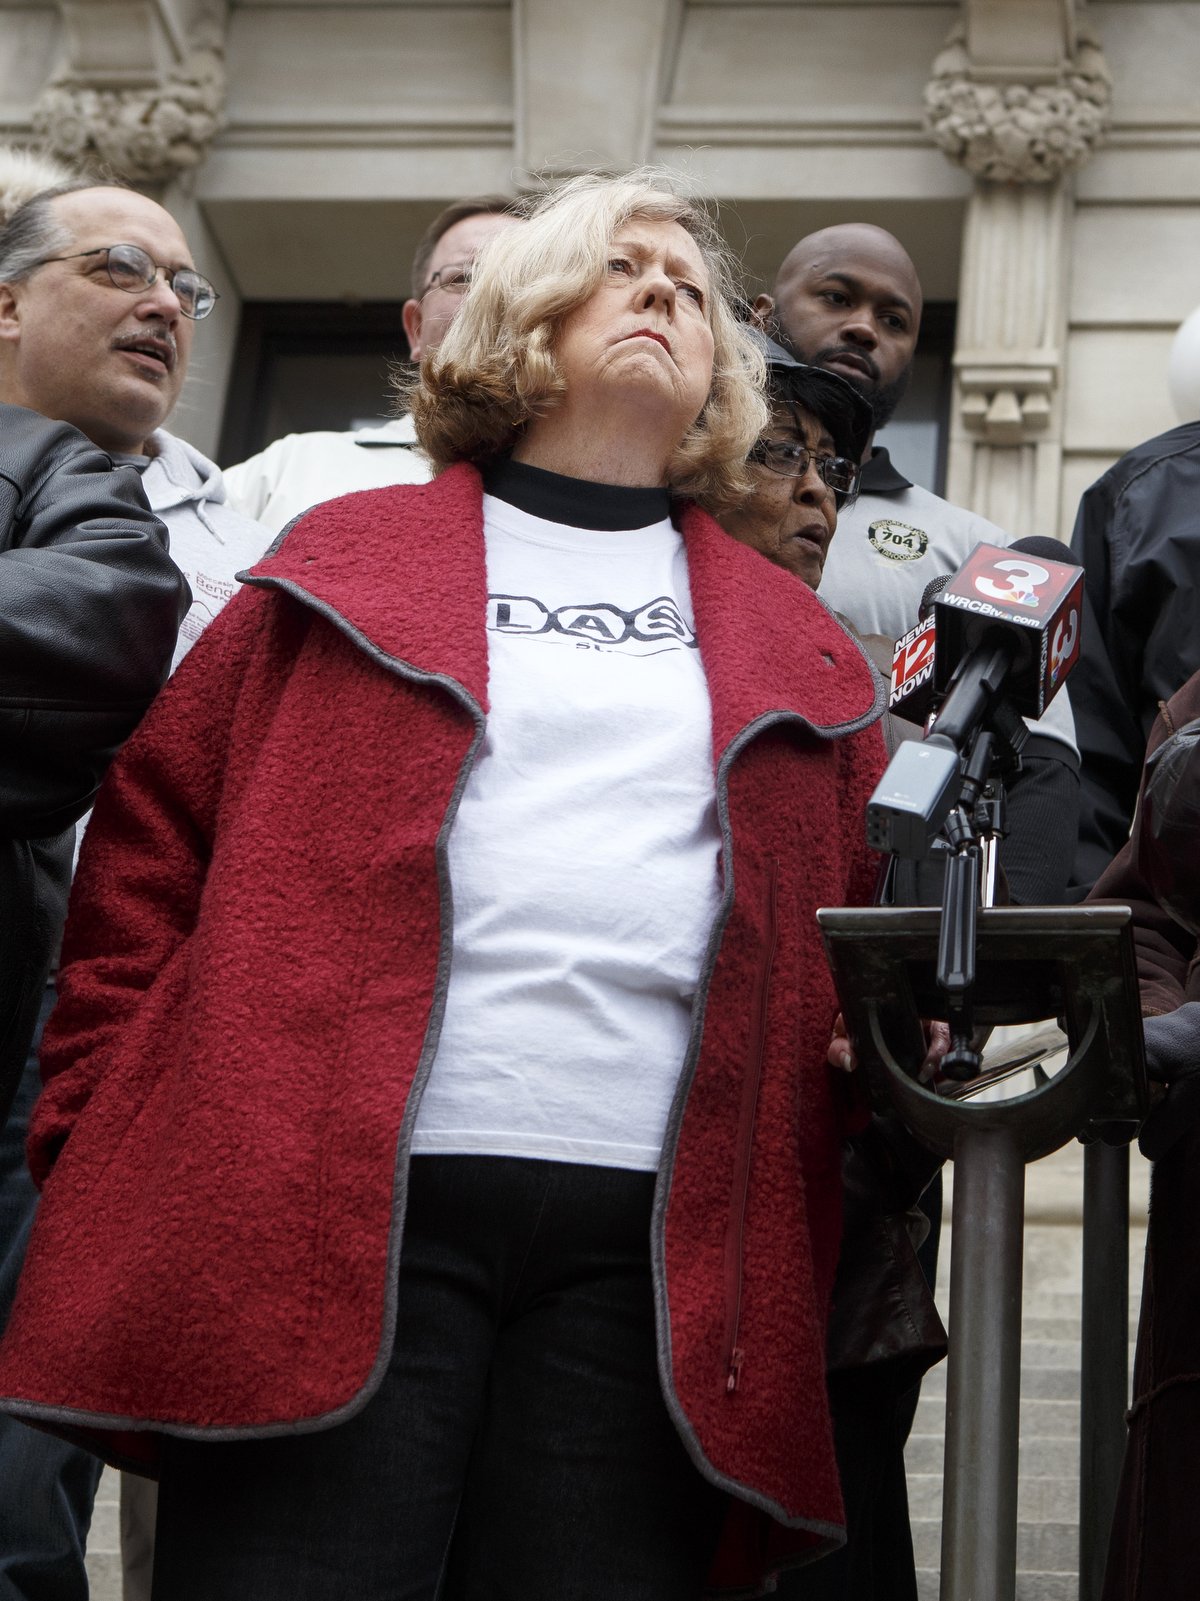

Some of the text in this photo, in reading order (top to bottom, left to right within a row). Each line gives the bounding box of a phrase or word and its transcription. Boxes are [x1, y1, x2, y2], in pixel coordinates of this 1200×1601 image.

[882, 531, 913, 549] 704
[196, 576, 233, 599] Bend
[974, 559, 1050, 602] 3
[895, 613, 936, 653] NEWS
[1051, 608, 1078, 666] 3
[892, 628, 936, 690] 12
[889, 662, 934, 707] NOW
